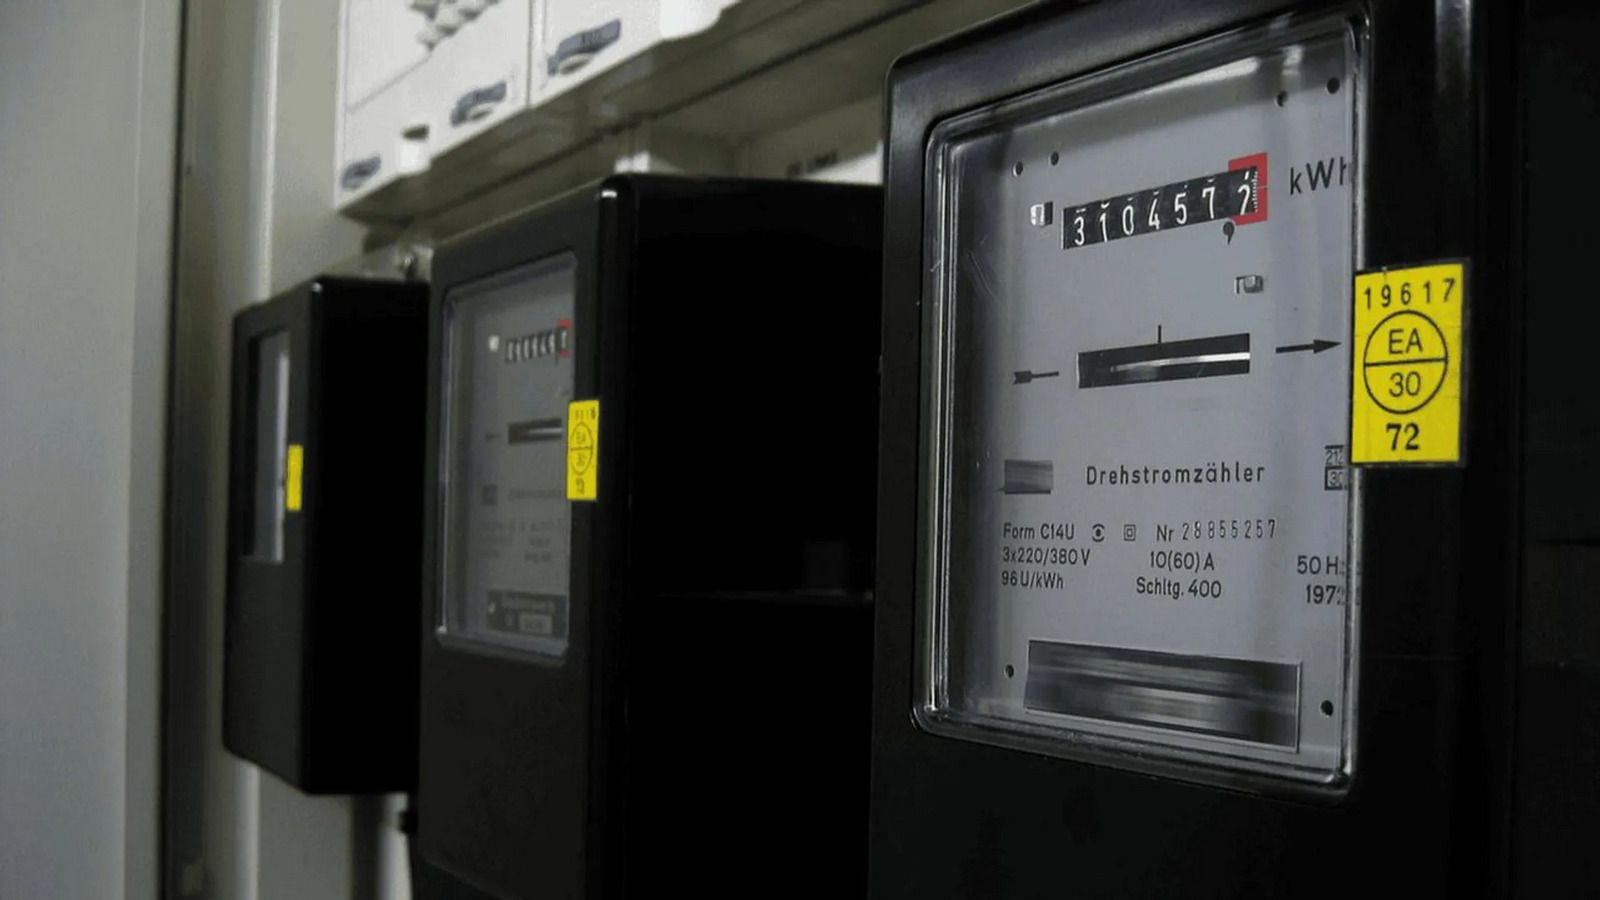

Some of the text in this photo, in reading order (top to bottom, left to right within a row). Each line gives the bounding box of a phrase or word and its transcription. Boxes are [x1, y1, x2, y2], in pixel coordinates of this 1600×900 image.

[1364, 278, 1455, 310] 19617
[1388, 328, 1424, 355] EA
[1388, 371, 1421, 398] 30
[1385, 422, 1420, 452] 72
[1086, 461, 1265, 486] Drehstromzähler
[1003, 522, 1074, 541] Form C14U
[1156, 524, 1174, 542] Nr
[1297, 555, 1321, 575] 50
[1136, 576, 1222, 600] Schltg. 400
